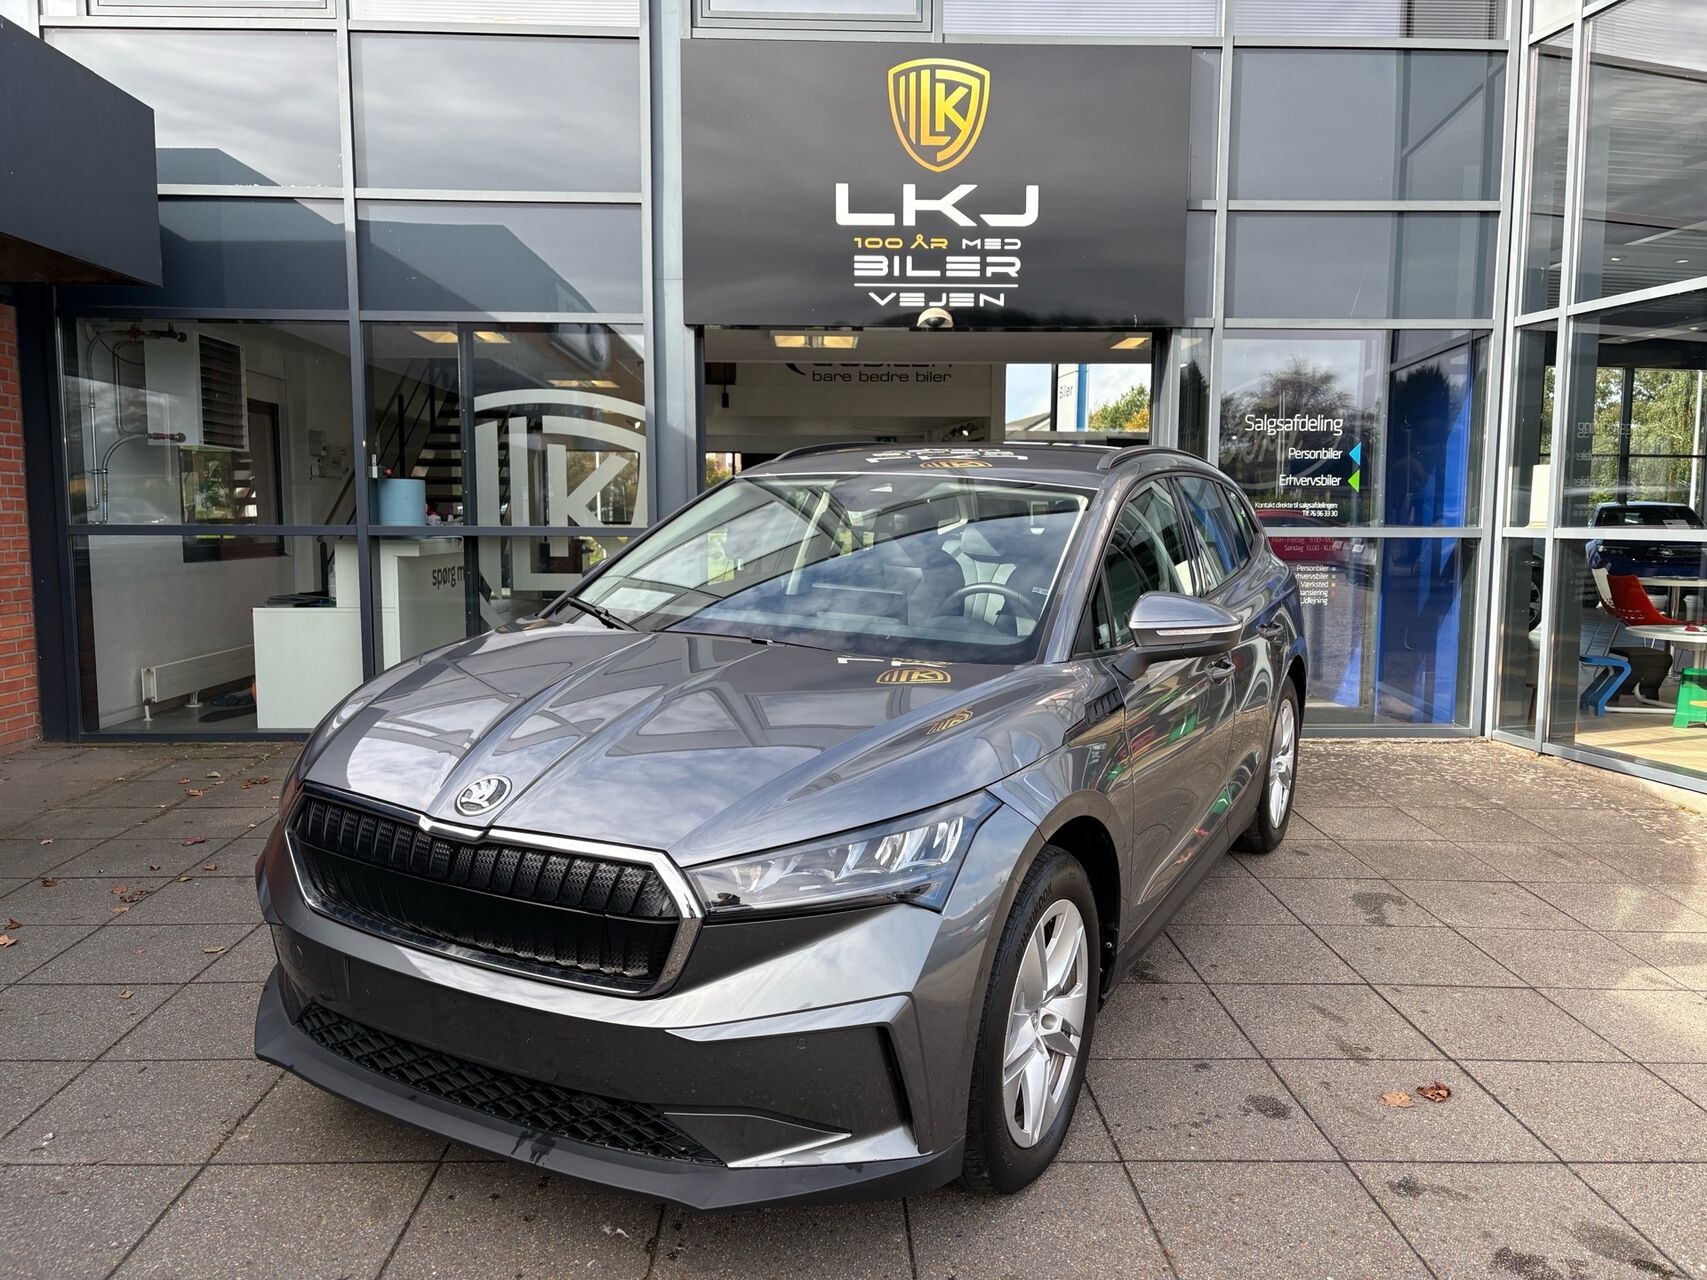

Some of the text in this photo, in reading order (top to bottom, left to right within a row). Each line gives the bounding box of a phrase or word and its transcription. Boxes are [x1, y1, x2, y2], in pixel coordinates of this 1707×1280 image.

[835, 182, 1040, 228] LKJ
[854, 234, 1022, 251] 100 ÅR MED
[853, 254, 1022, 278] BILER
[868, 292, 1005, 308] VEJEN
[811, 370, 953, 383] bare bedre biler
[1244, 413, 1344, 437] Salgsafdeling
[1288, 447, 1343, 460] Personbiler
[1279, 473, 1342, 487] Erhvervsbiler
